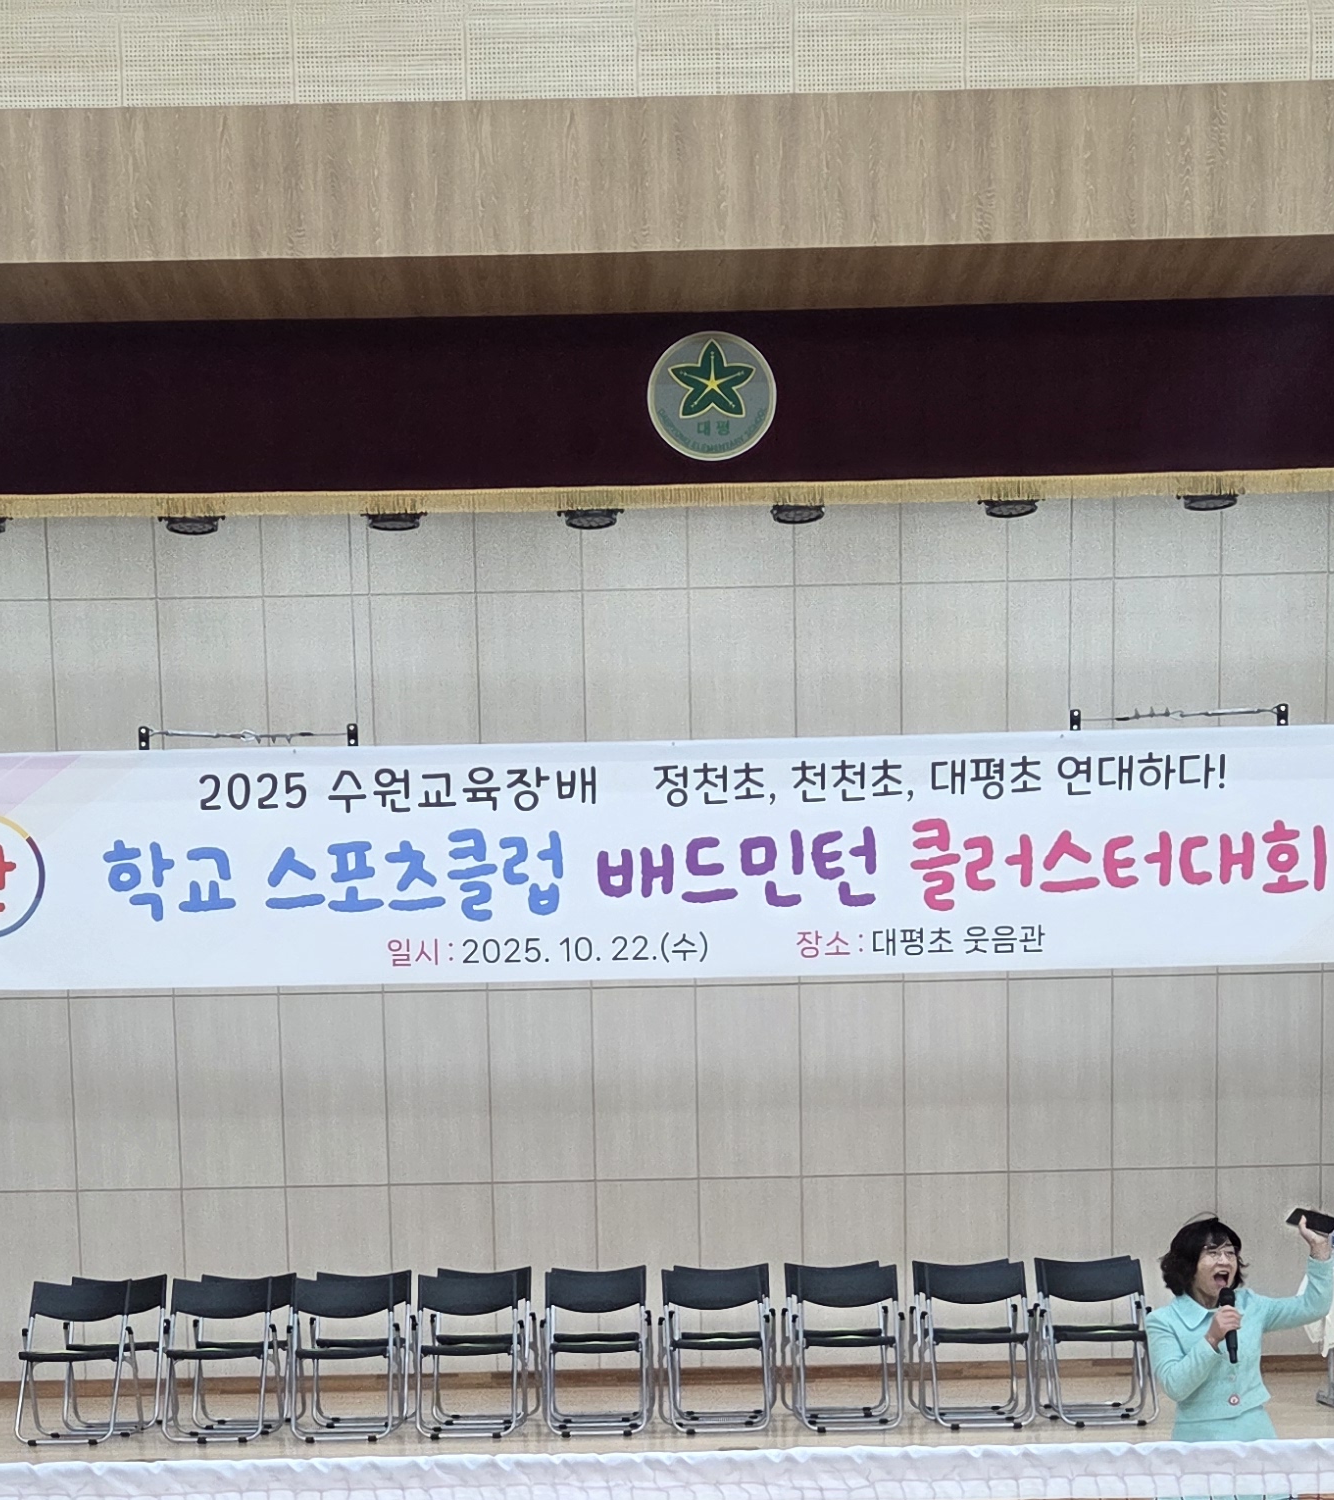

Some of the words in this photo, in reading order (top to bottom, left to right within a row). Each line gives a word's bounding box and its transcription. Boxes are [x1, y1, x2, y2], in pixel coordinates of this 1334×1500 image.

[199, 772, 307, 811] 2025
[653, 762, 776, 808] 정천초,
[791, 758, 914, 803] 천천초,
[930, 755, 1042, 800] 대평초
[1056, 751, 1226, 796] 연대하다!
[103, 840, 236, 921] 학교
[265, 828, 564, 921] 스포츠클럽
[596, 826, 877, 907] 배드민턴
[911, 819, 1327, 911] 클러스터대회
[872, 927, 954, 956] 대평초
[963, 924, 1046, 955] 웃음관
